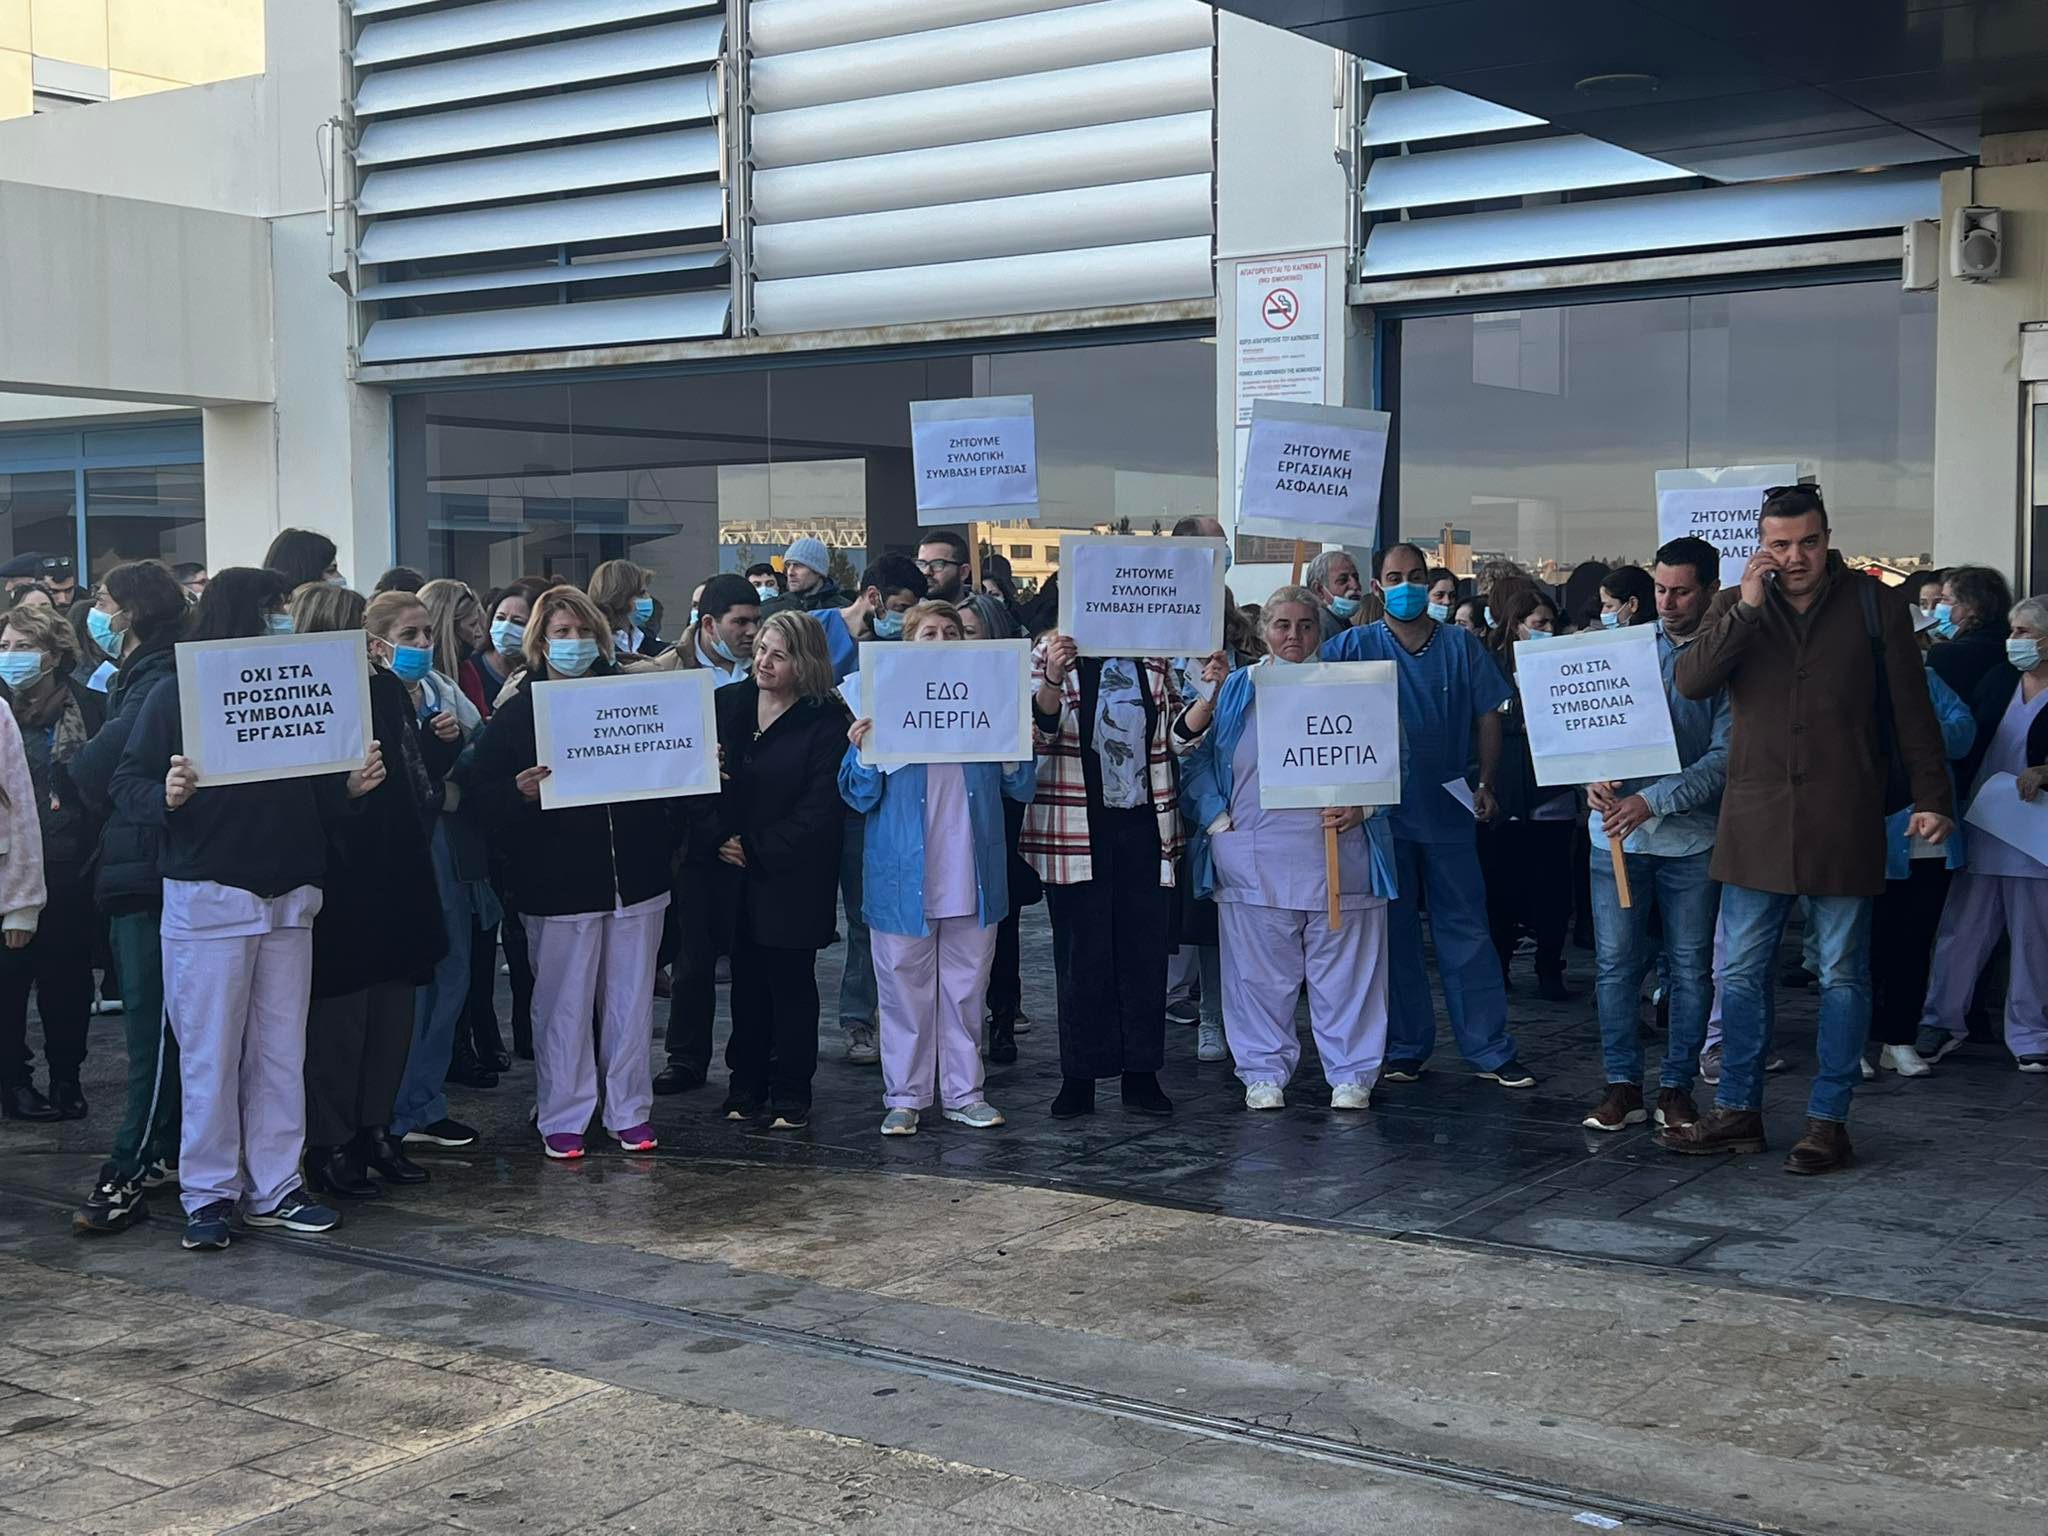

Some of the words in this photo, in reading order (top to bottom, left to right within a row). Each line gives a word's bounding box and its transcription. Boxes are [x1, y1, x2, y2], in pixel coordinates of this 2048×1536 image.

[949, 436, 1001, 449] ΖΗΤΟΥΜΕ
[947, 451, 1004, 463] ΣΥΛΛΟΓΙΚΗ
[1283, 443, 1352, 462] ΖΗΤΟΥΜΕ
[926, 467, 977, 479] ΣΥΜΒΑΣΗ
[979, 464, 1028, 477] ΕΡΓΑΣΙΑΣ
[1277, 460, 1352, 480] ΕΡΓΑΣΙΑΚΗ
[1275, 478, 1349, 497] ΑΣΦΑΛΕΙΑ
[1691, 509, 1760, 523] ΖΗΤΟΥΜΕ
[1115, 568, 1175, 580] ΖΗΤΟΥΜΕ
[1111, 585, 1177, 597] ΣΥΛΛΟΓΙΚΗ
[1085, 601, 1144, 613] ΣΥΜΒΑΣΗ
[1147, 603, 1201, 615] ΕΡΓΑΣΙΑΣ
[240, 667, 273, 683] ΟΧΙ
[278, 664, 313, 679] ΣΤΑ
[1560, 664, 1583, 676] ΟΧΙ
[1587, 659, 1612, 673] ΣΤΑ
[223, 682, 332, 706] ΠΡΟΣΩΠΙΚΑ
[926, 681, 969, 701] ΕΔΩ
[1550, 676, 1631, 697] ΠΡΟΣΩΠΙΚΑ
[224, 701, 334, 725] ΣΥΜΒΟΛΑΙΑ
[595, 704, 659, 721] ΖΗΤΟΥΜΕ
[1552, 694, 1634, 715] ΣΥΜΒΟΛΑΙΑ
[902, 710, 991, 729] ΑΠΕΡΓΙΑ
[1306, 714, 1353, 735] ΕΔΩ
[1565, 713, 1628, 731] ΕΡΓΑΣΙΑΣ
[236, 720, 326, 743] ΕΡΓΑΣΙΑΣ
[593, 722, 664, 739] ΣΥΛΛΟΓΙΚΗ
[566, 744, 631, 759] ΣΥΜΒΑΣΗ
[634, 737, 693, 754] ΕΡΓΑΣΙΑΣ
[1282, 745, 1378, 768] ΑΠΕΡΓΙΑ
